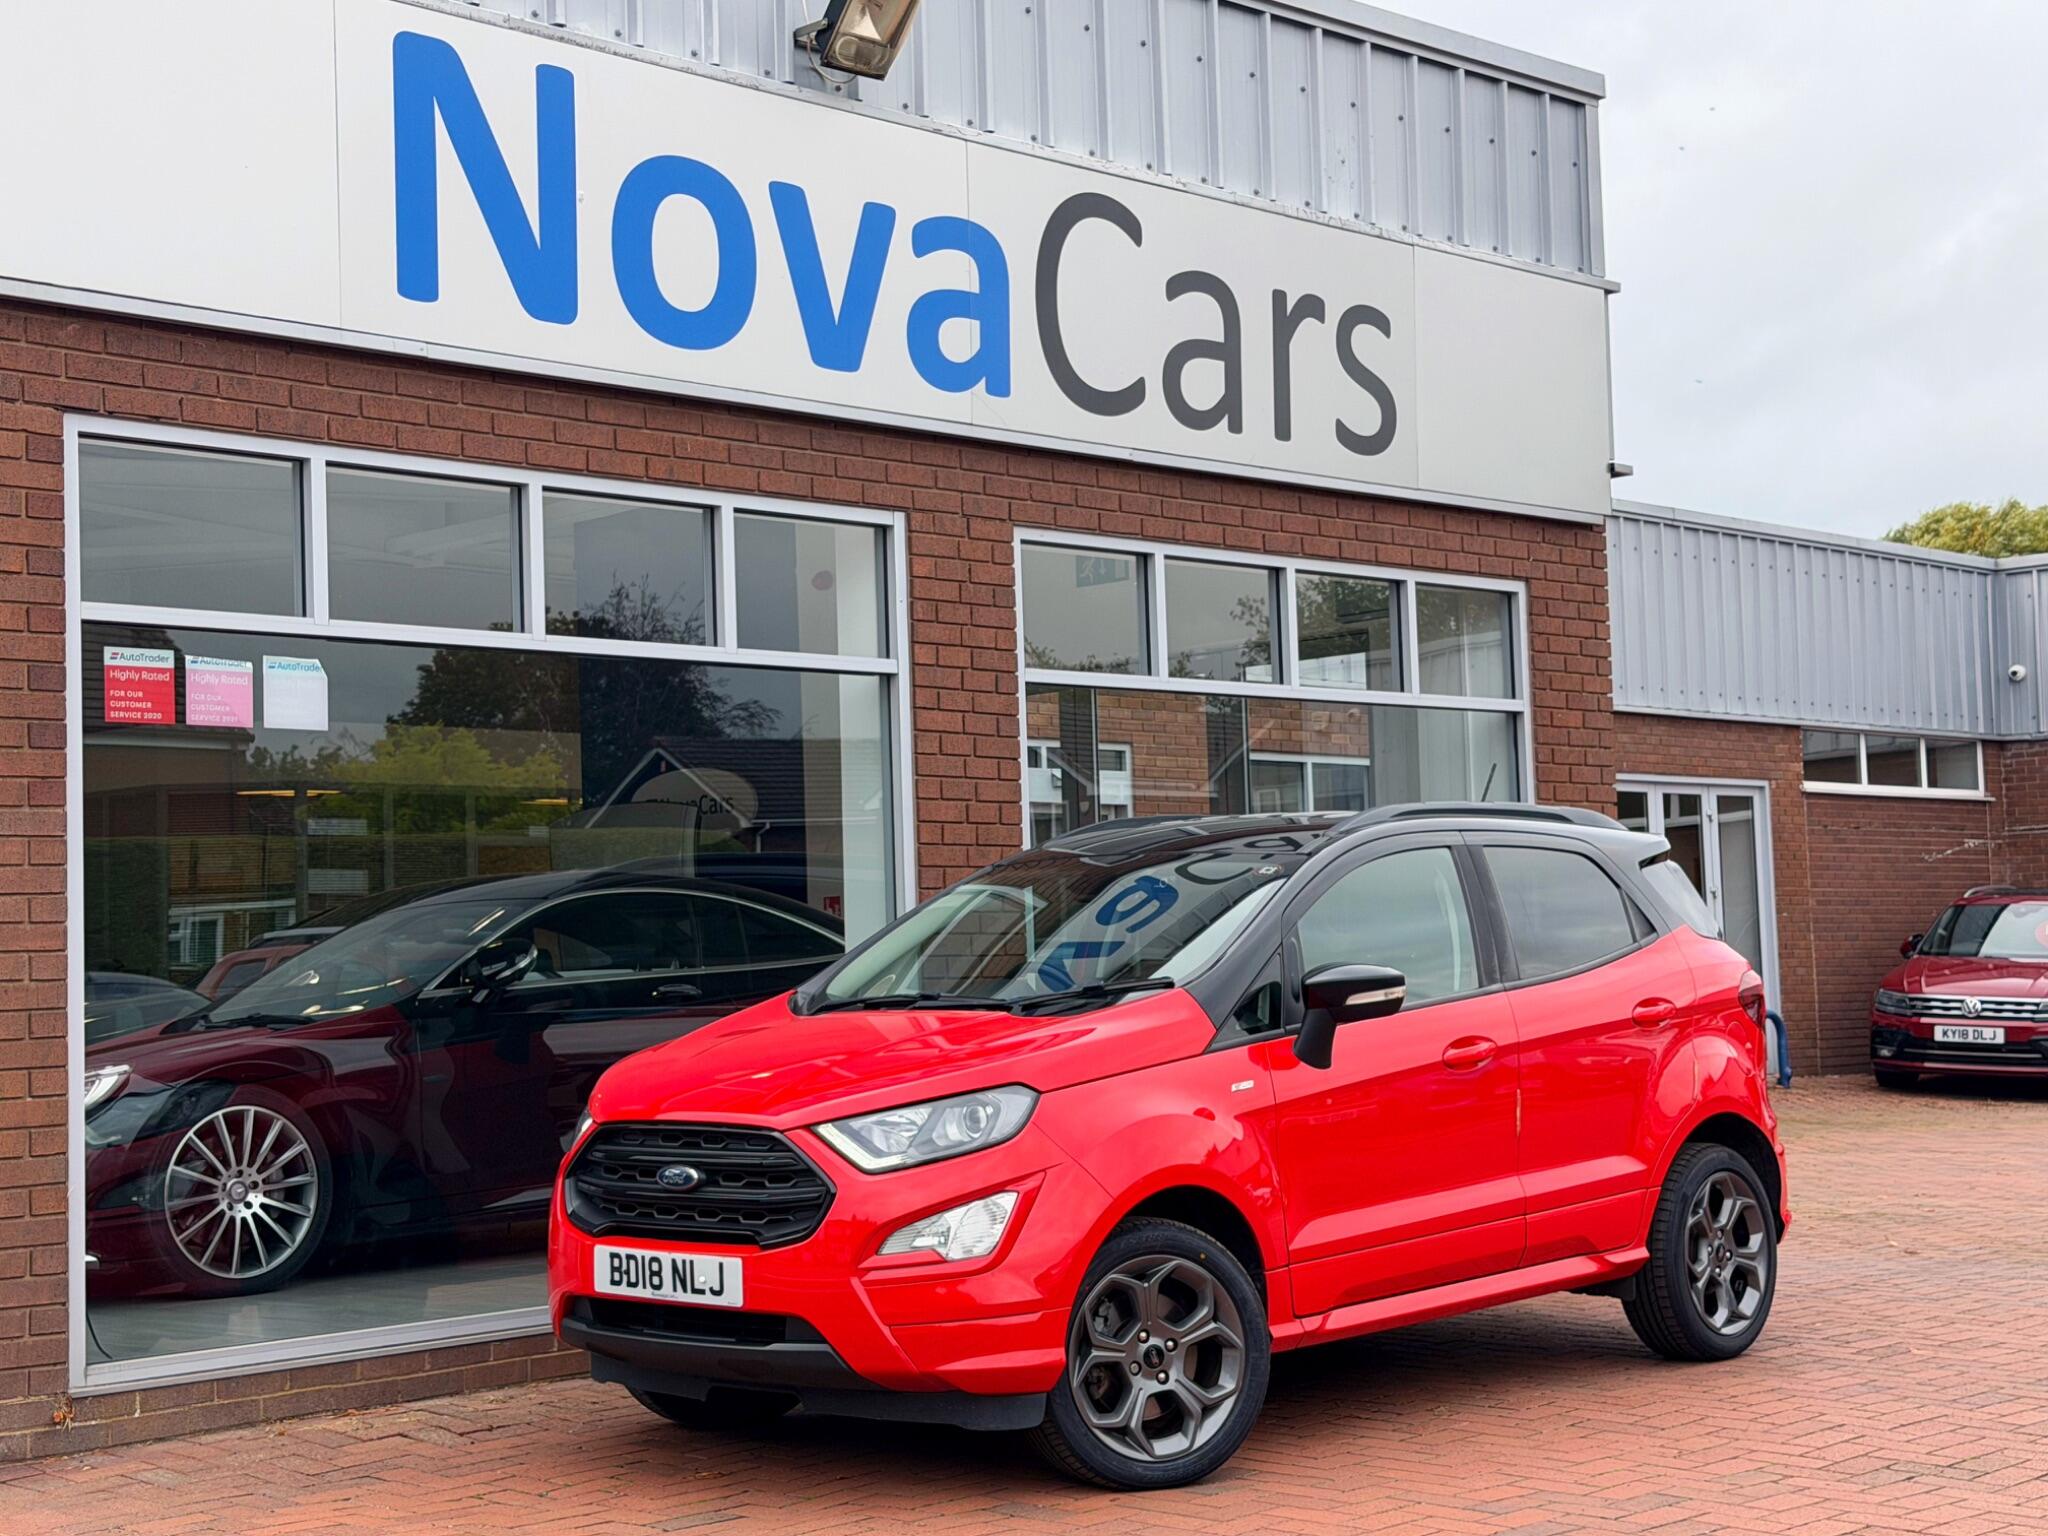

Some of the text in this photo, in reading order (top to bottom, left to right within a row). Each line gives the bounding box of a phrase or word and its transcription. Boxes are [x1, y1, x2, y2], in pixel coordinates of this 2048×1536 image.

[393, 31, 1397, 457] NovaCars
[120, 652, 170, 663] AutoTrader
[277, 662, 321, 672] AutoTrade
[110, 669, 170, 682] Highly Rated
[191, 673, 248, 686] Highly Rated
[127, 690, 143, 698] OUR
[110, 700, 152, 709] CUSTOMER
[110, 711, 162, 720] SERVICE 2020
[1942, 1028, 1997, 1040] KY18 DLJ
[609, 1252, 724, 1296] BD18 NLJ
